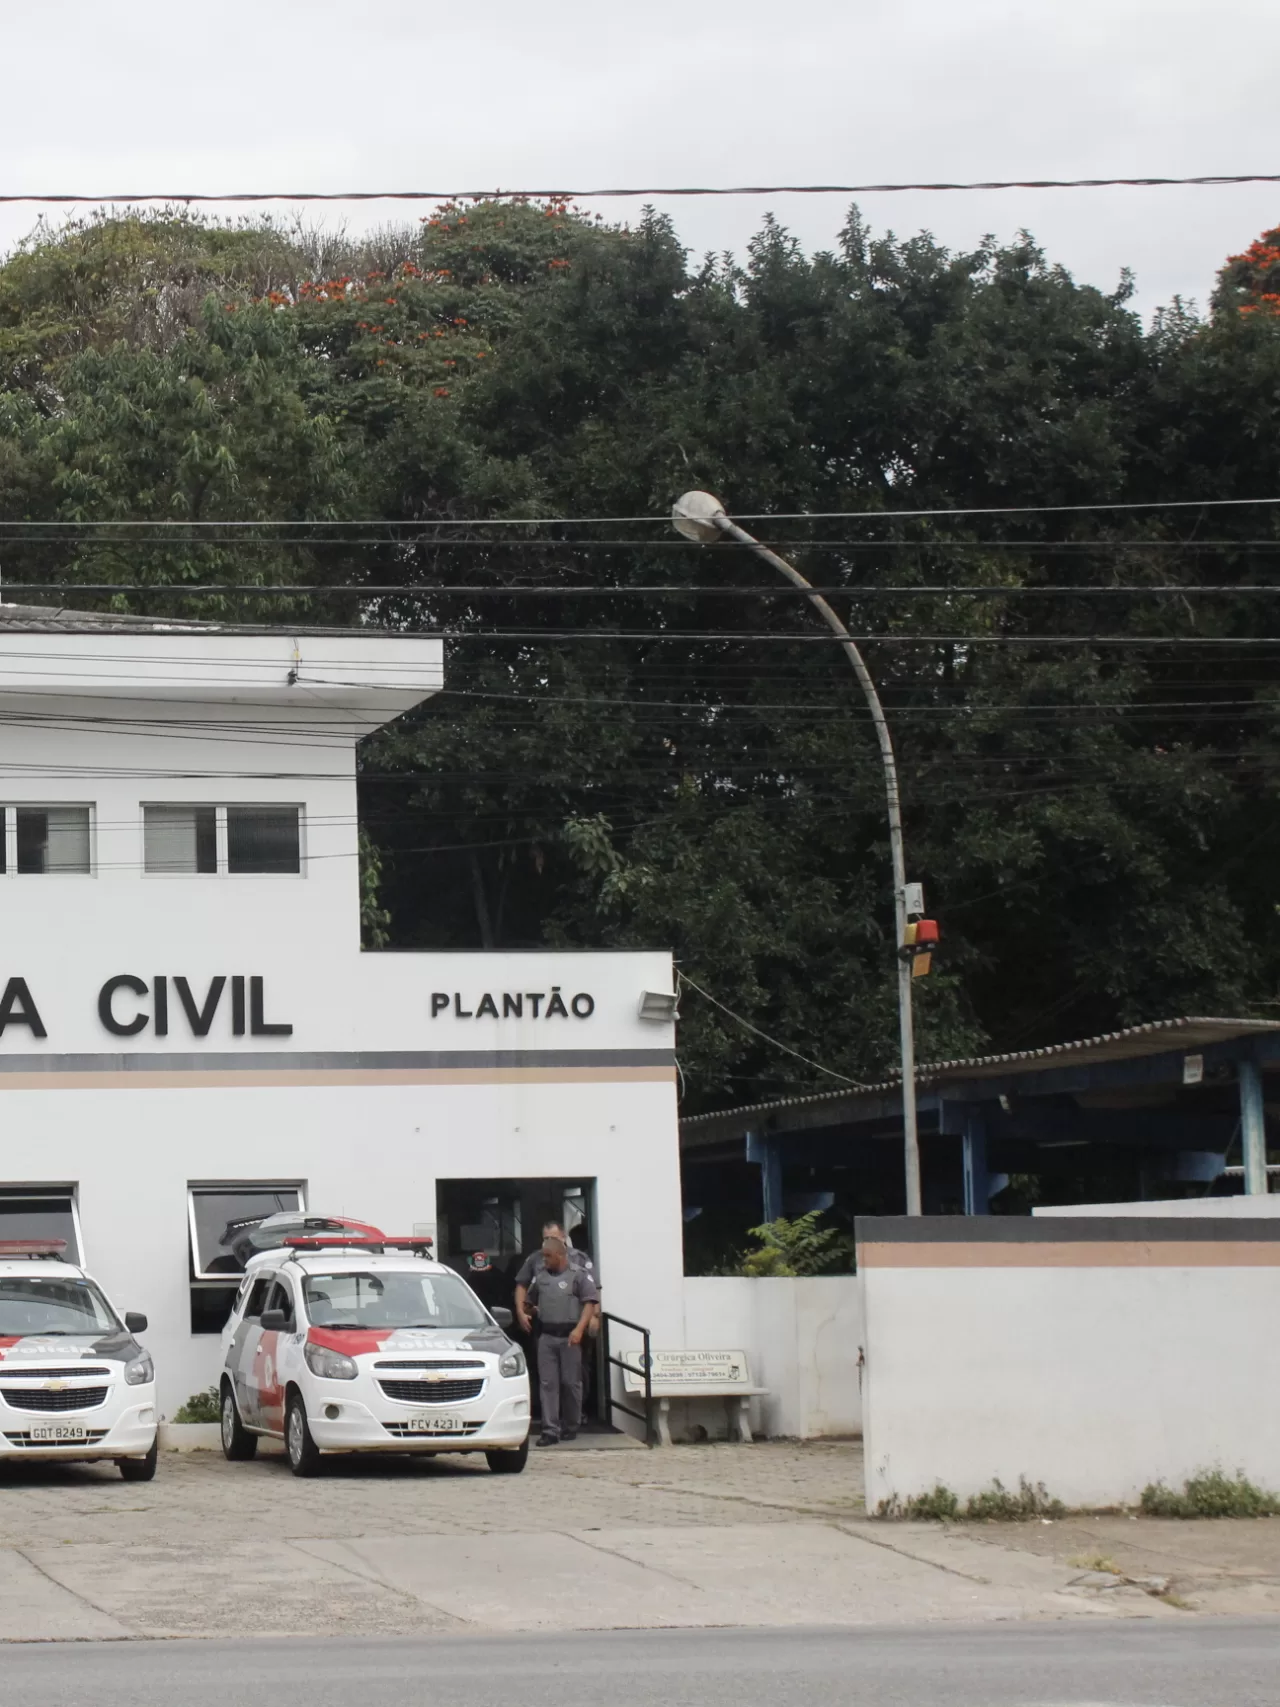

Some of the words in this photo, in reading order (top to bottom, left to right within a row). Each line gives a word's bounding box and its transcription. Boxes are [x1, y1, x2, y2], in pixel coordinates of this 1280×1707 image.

[98, 974, 293, 1038] CIVIL
[431, 986, 596, 1020] PLANTÃO
[698, 1352, 731, 1361] Oliveira
